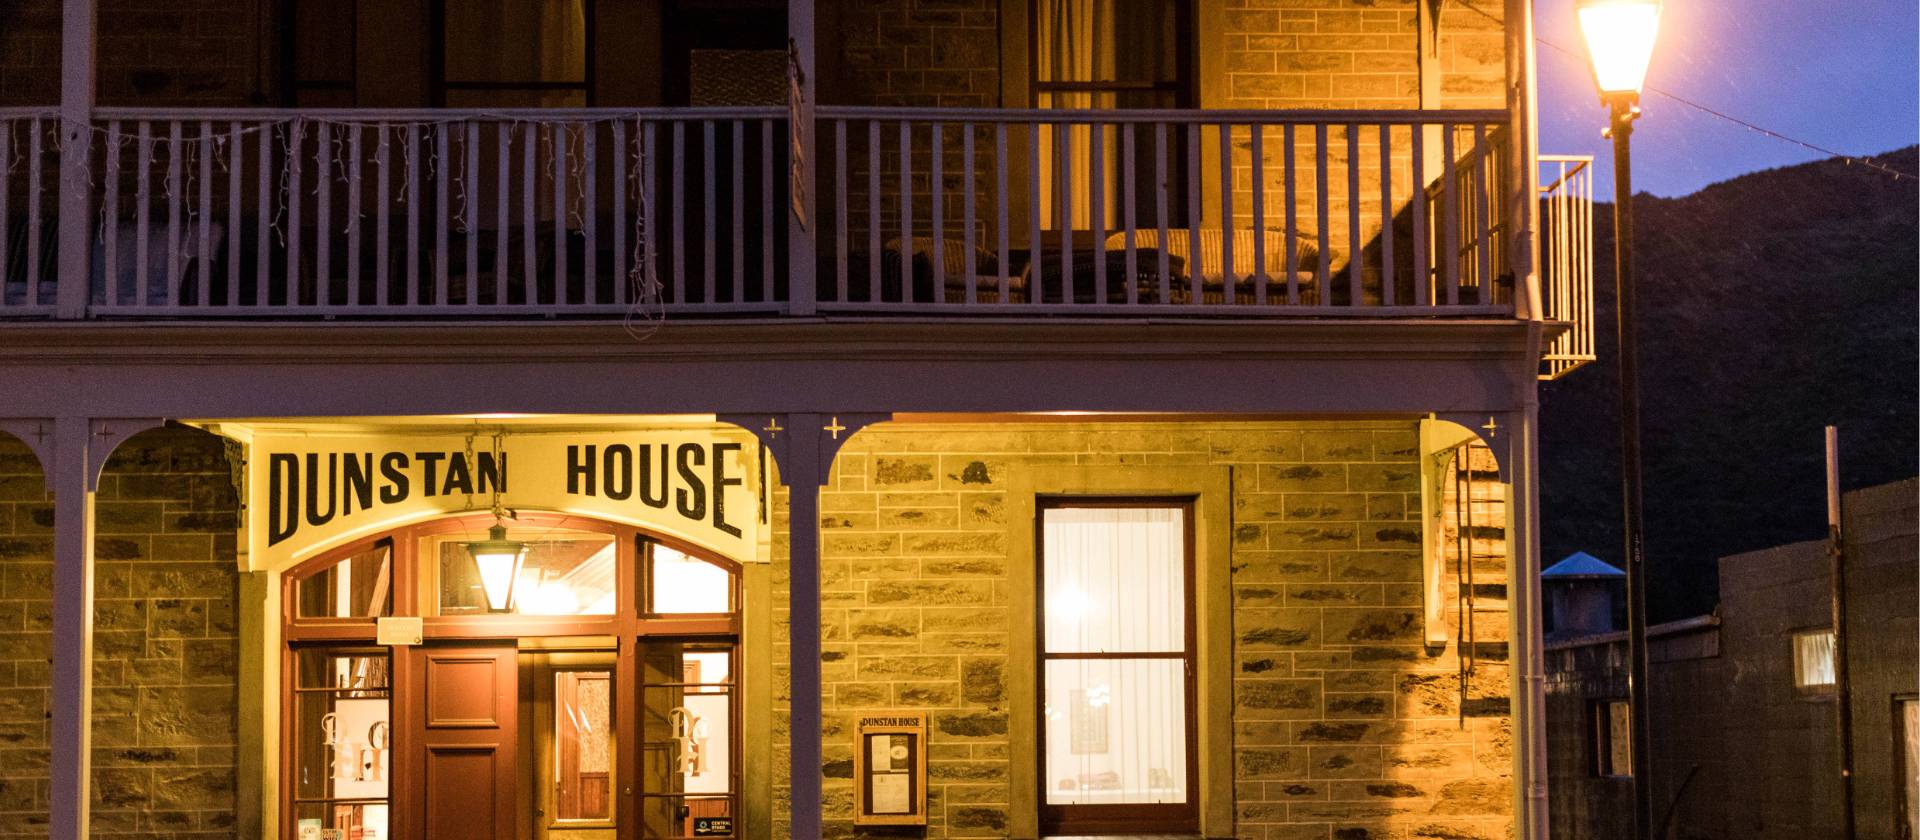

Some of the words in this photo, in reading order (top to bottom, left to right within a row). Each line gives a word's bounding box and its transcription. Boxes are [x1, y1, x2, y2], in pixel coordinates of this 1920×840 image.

[267, 451, 508, 548] DUNSTAN
[566, 442, 743, 539] HOUSE
[861, 717, 897, 727] DUNSTAN
[898, 717, 919, 727] HOUSE
